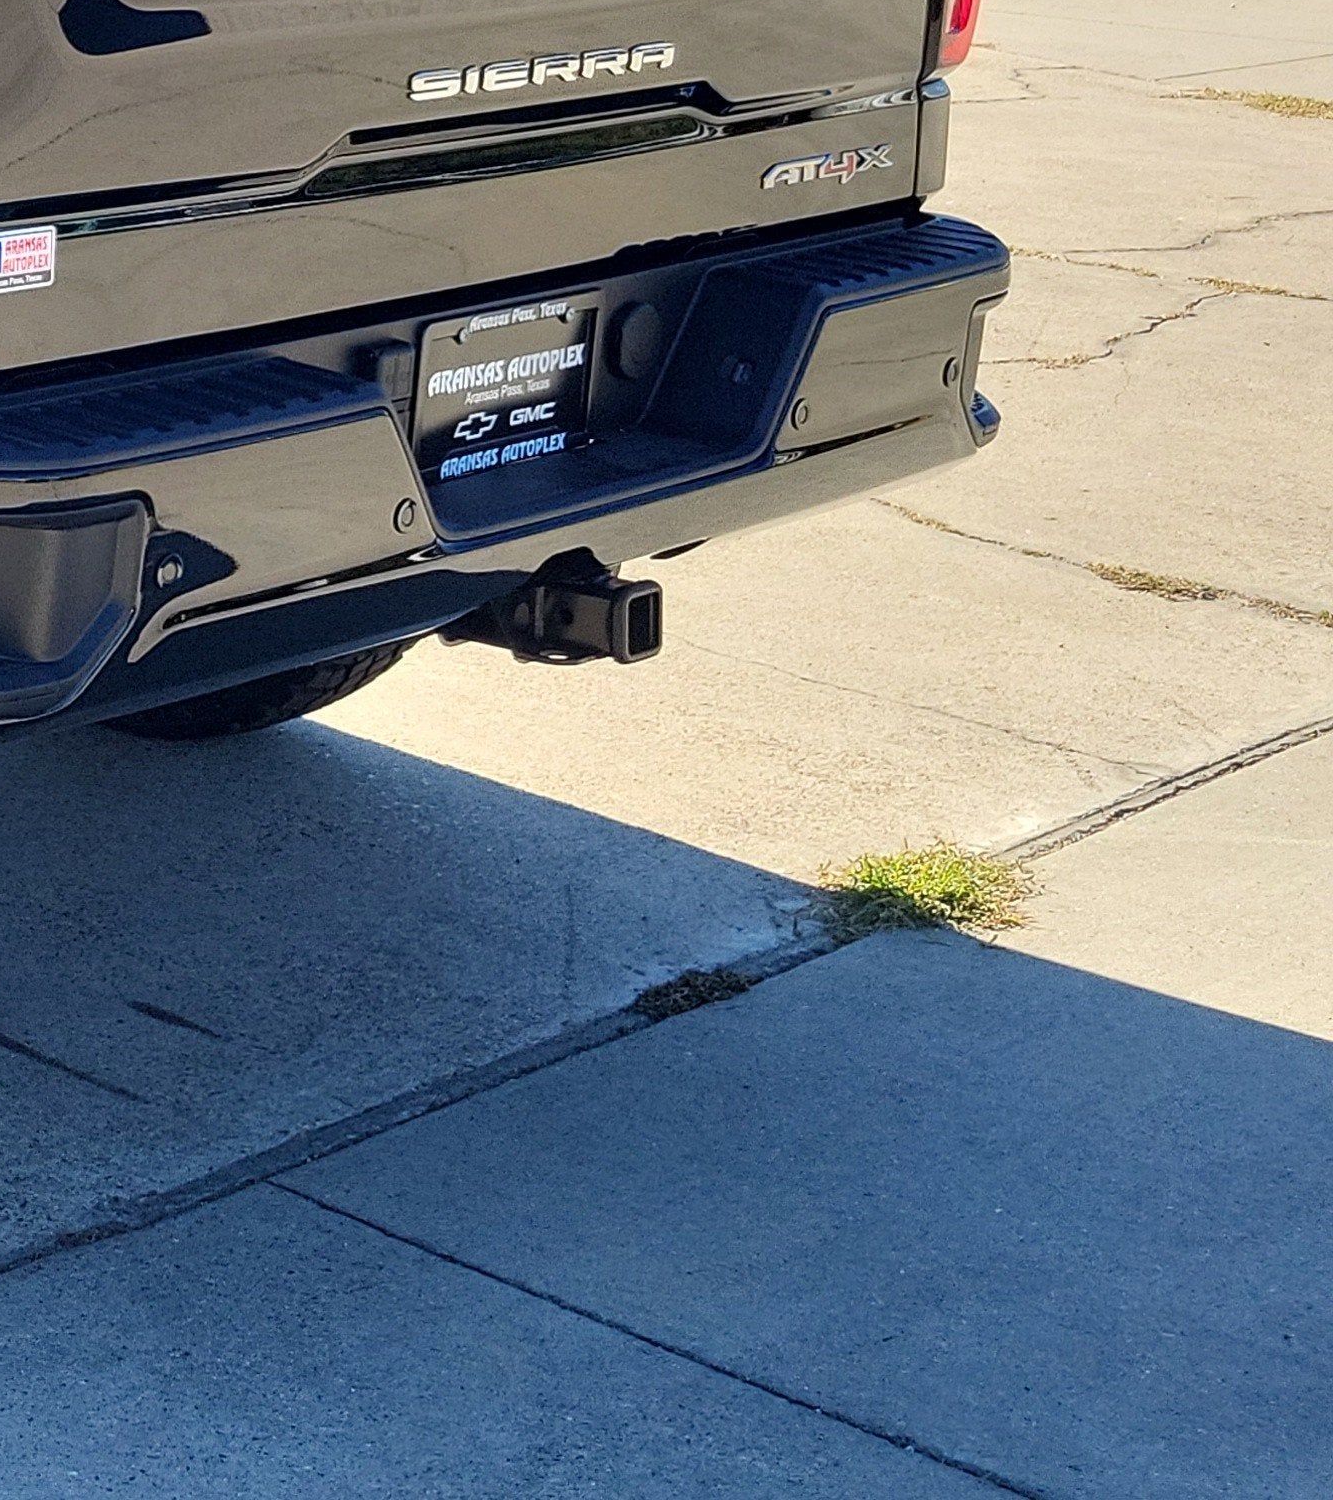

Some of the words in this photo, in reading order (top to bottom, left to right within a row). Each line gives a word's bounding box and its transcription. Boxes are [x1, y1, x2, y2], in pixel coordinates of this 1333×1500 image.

[408, 41, 675, 101] SIERRA
[761, 143, 893, 189] AT4X
[2, 253, 48, 274] AUTOPLEX
[5, 236, 48, 257] ARANSAS
[428, 360, 505, 397] ARANSAS
[507, 343, 586, 382] AUTOPLEX
[509, 402, 556, 426] GMC
[440, 447, 499, 480] ARANSAS
[501, 432, 567, 466] AUTOPLEX
